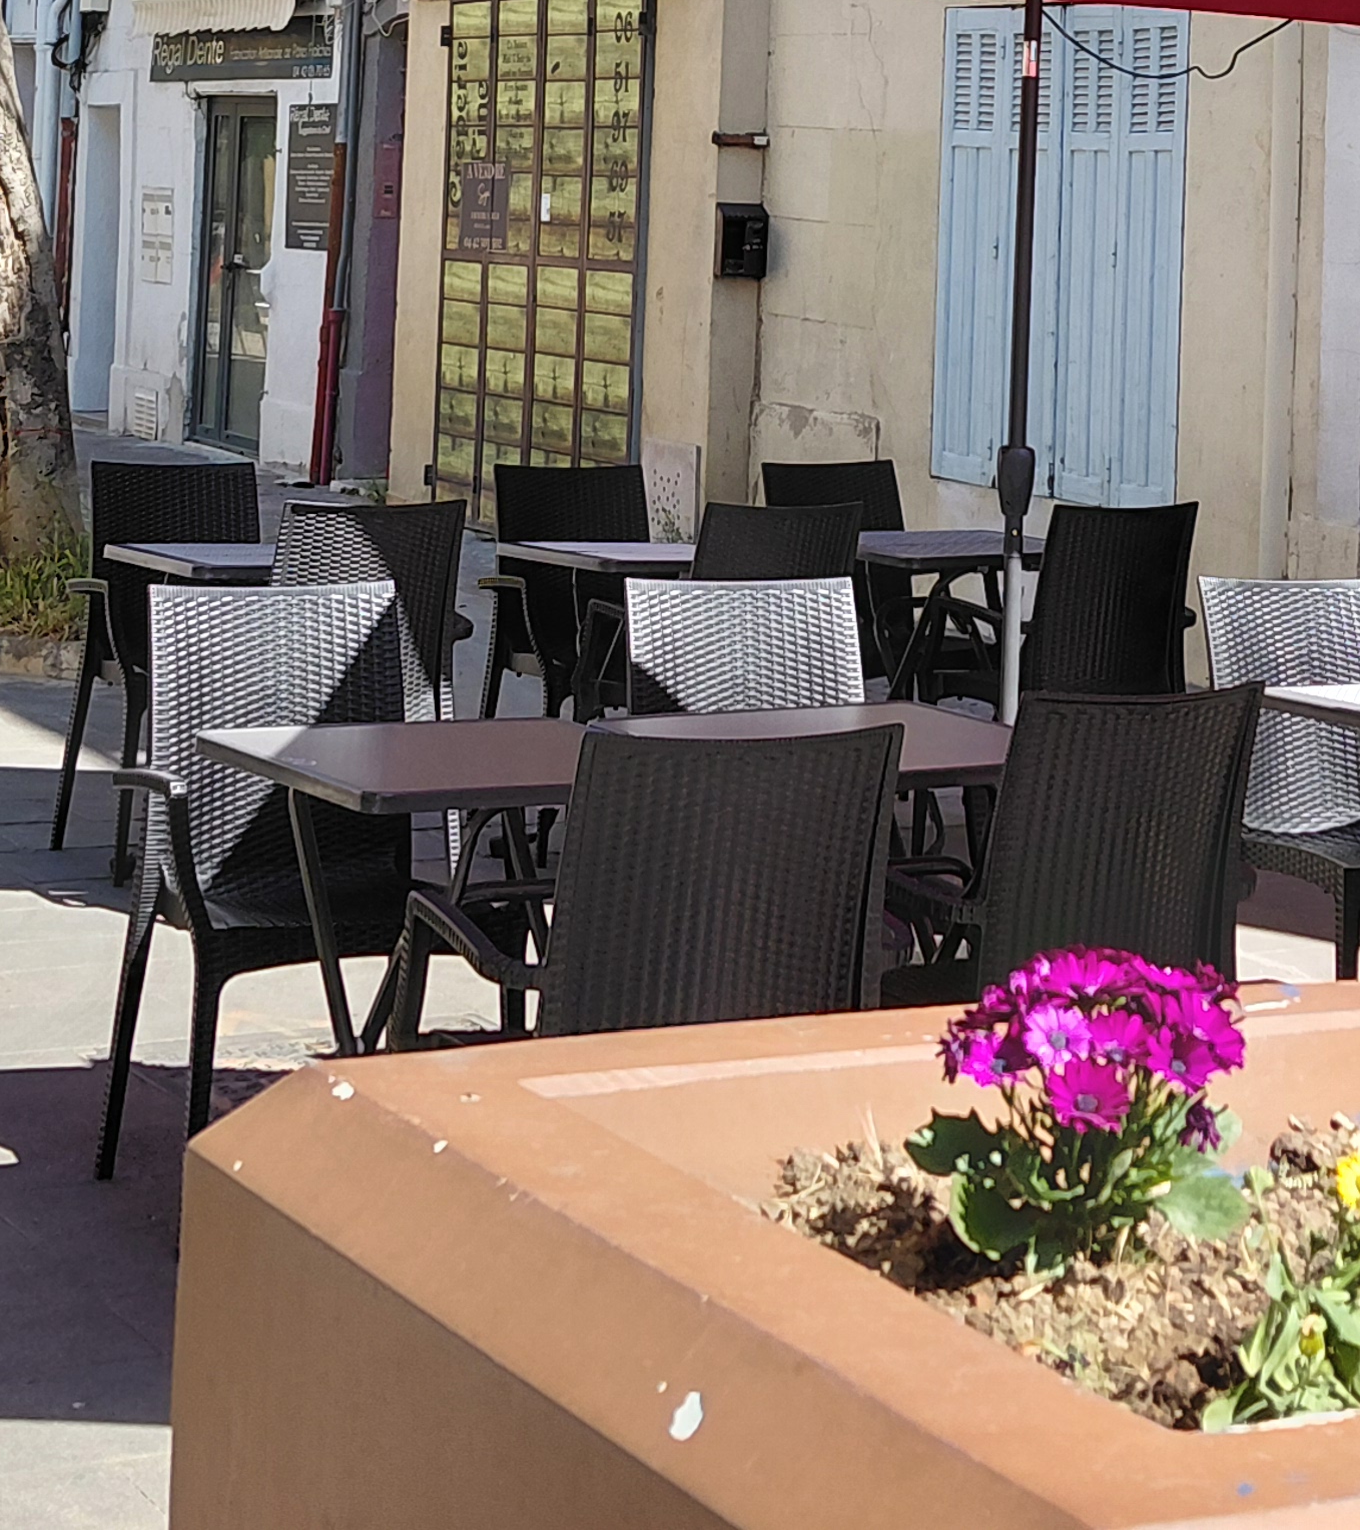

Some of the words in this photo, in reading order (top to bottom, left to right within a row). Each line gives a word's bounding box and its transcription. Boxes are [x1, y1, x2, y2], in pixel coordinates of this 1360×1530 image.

[614, 11, 634, 44] 06
[152, 36, 185, 75] Régal
[614, 60, 630, 94] 51
[611, 109, 630, 143] 97
